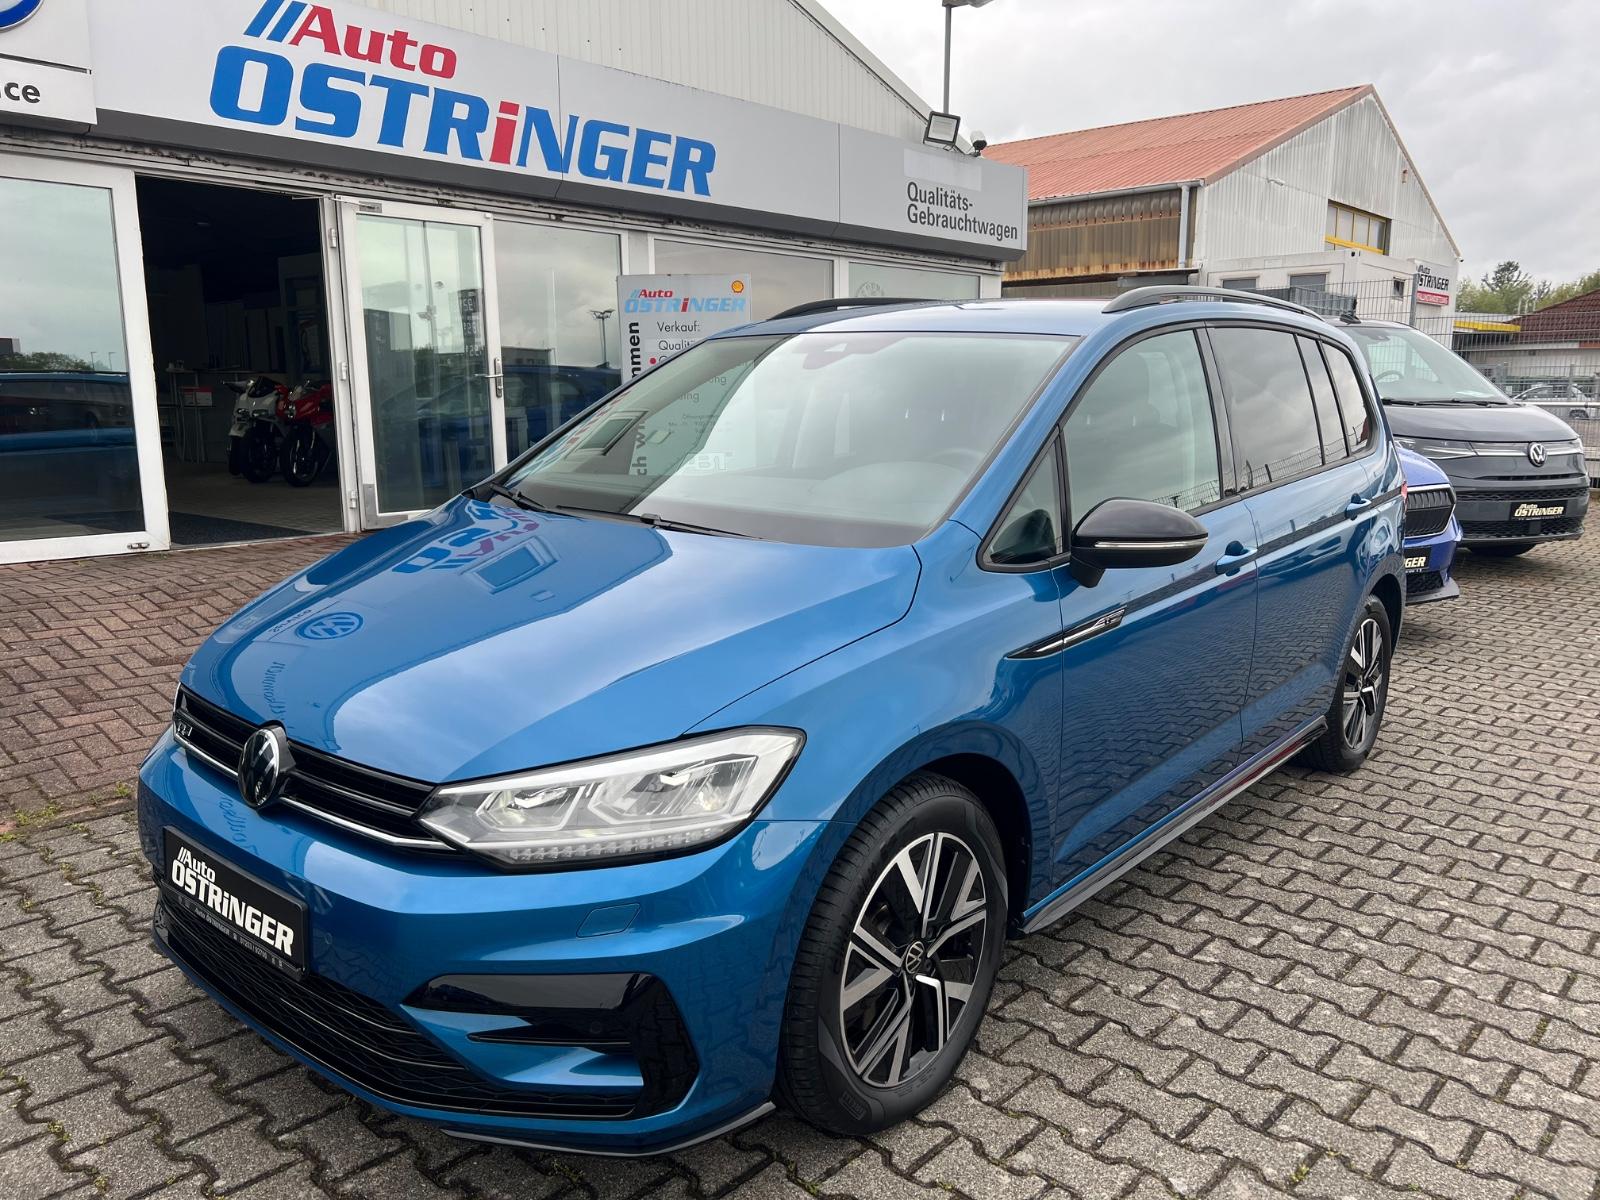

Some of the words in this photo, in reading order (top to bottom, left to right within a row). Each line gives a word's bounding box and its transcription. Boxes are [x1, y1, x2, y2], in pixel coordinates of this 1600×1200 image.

[289, 5, 457, 80] Auto
[0, 82, 41, 104] ce
[907, 181, 973, 212] Qualitäts-
[907, 203, 1018, 242] Gebrauchtwagen
[638, 288, 673, 299] Auto
[657, 320, 701, 333] Verkauf:
[182, 853, 215, 881] Auto
